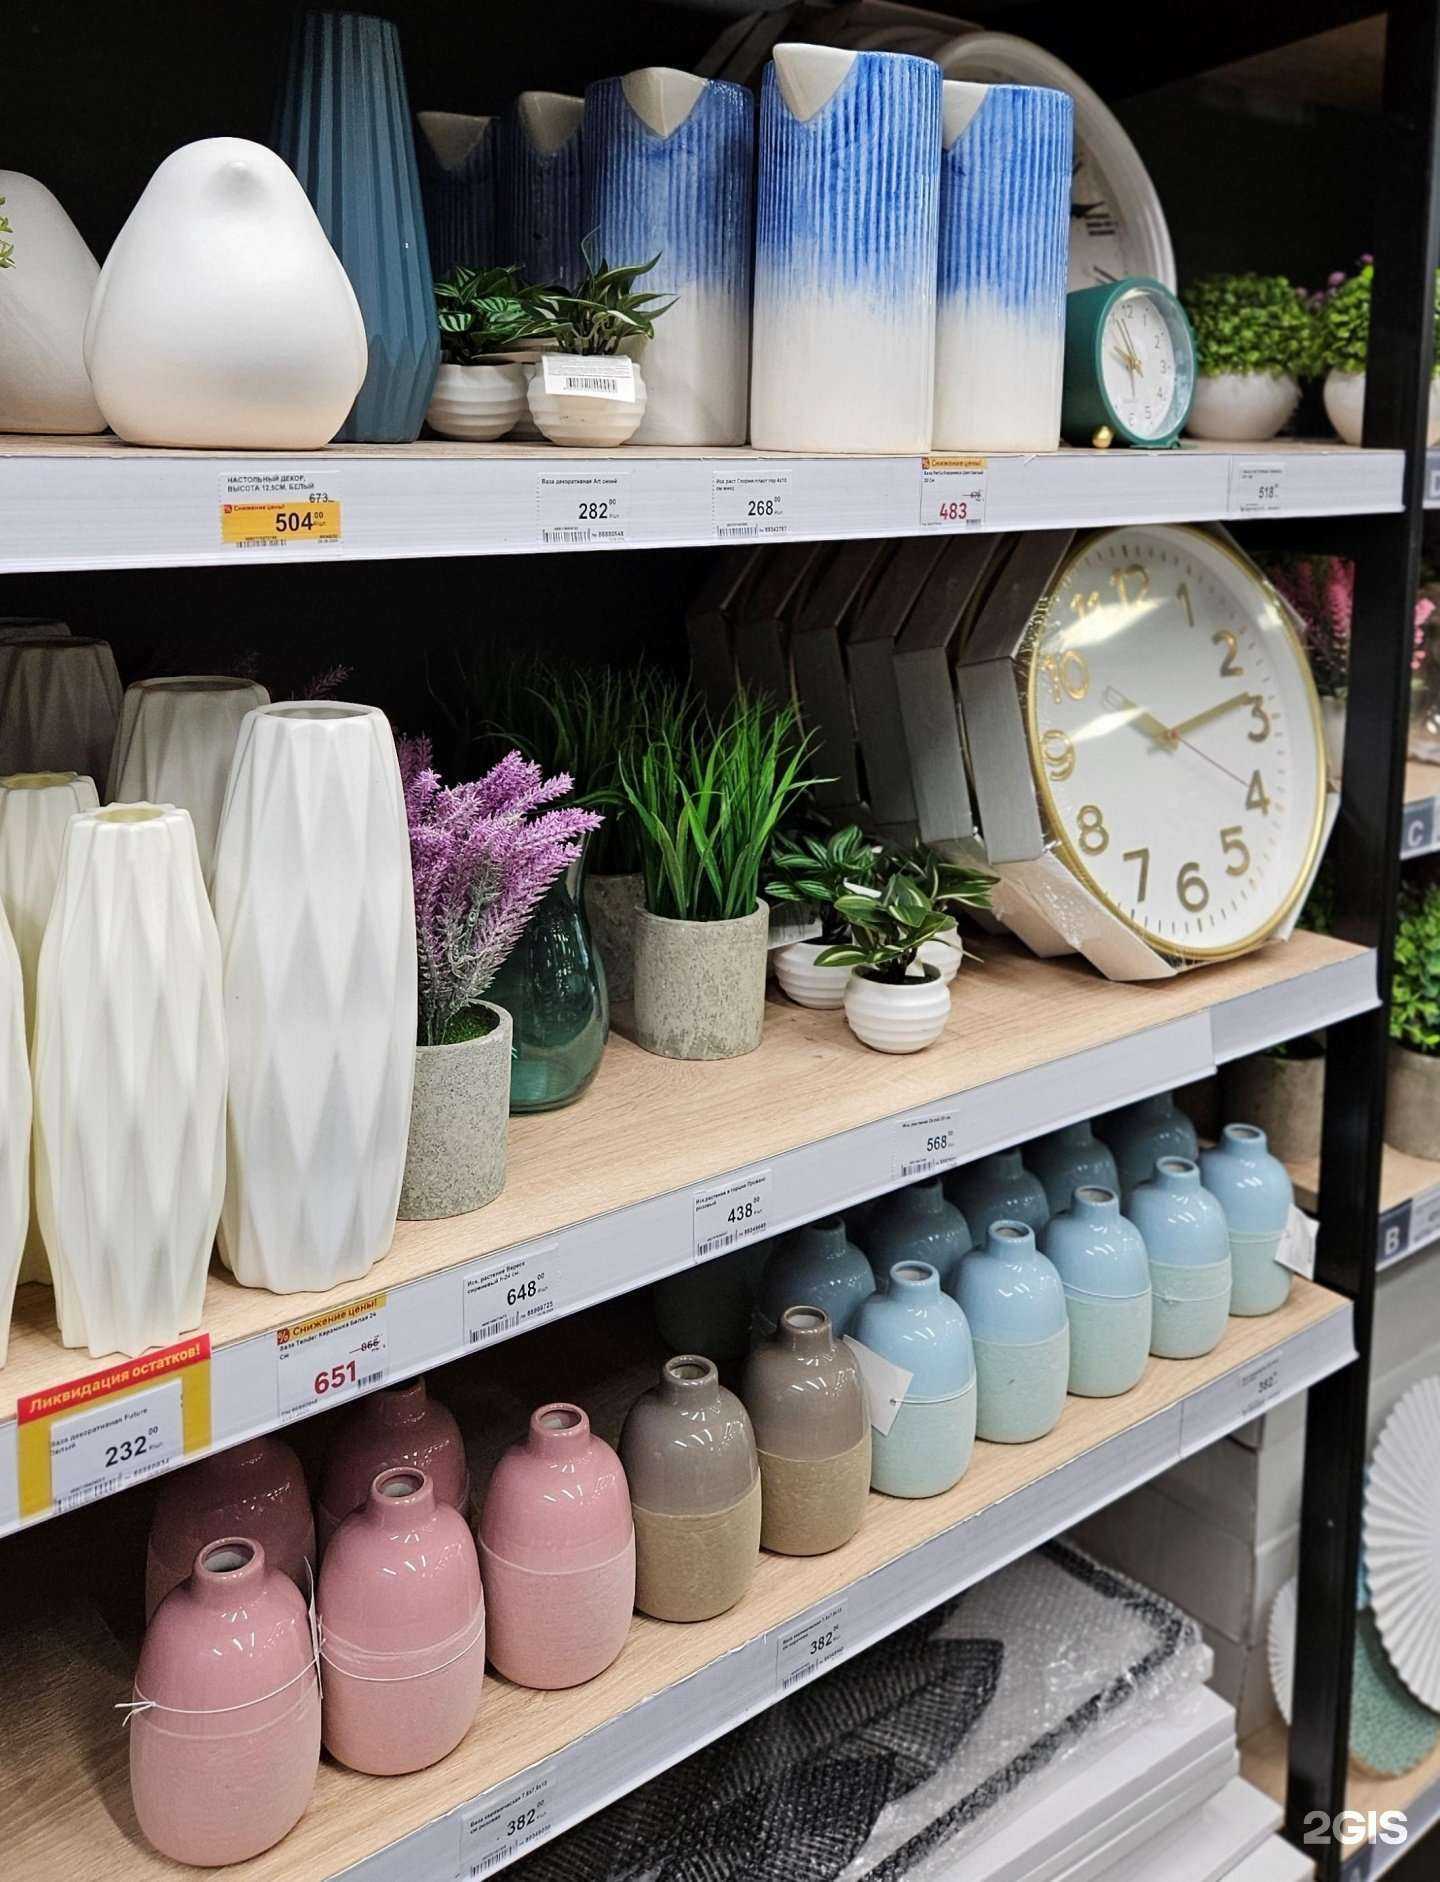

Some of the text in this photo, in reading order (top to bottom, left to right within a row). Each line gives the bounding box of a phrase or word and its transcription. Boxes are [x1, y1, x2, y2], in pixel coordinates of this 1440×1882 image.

[309, 493, 328, 503] 673
[579, 503, 608, 519] 282
[748, 500, 773, 516] 268
[939, 502, 967, 520] 483
[275, 512, 313, 532] 504
[1176, 583, 1195, 627] 1
[1212, 630, 1245, 678] 2
[1041, 649, 1090, 704] 10
[1247, 695, 1270, 744] 3
[1041, 729, 1075, 781] 9
[1245, 770, 1270, 816] 4
[1077, 804, 1110, 857] 8
[1408, 820, 1423, 847] C
[1220, 825, 1251, 877] 5
[1123, 848, 1150, 903] 7
[1176, 862, 1210, 913] 6
[927, 1135, 947, 1152] 568
[727, 1203, 753, 1223] 438
[1385, 1226, 1400, 1255] B
[480, 1269, 505, 1281] растение
[507, 1280, 536, 1305] 648
[293, 1298, 377, 1336] Снижение цены!
[29, 1344, 200, 1413] Ликвидация остатков!
[314, 1360, 356, 1394] 651
[70, 1416, 123, 1440] декоративная
[124, 1407, 148, 1421] Future
[105, 1426, 158, 1468] 232 00
[810, 1632, 832, 1655] 382
[507, 1809, 535, 1836] 382
